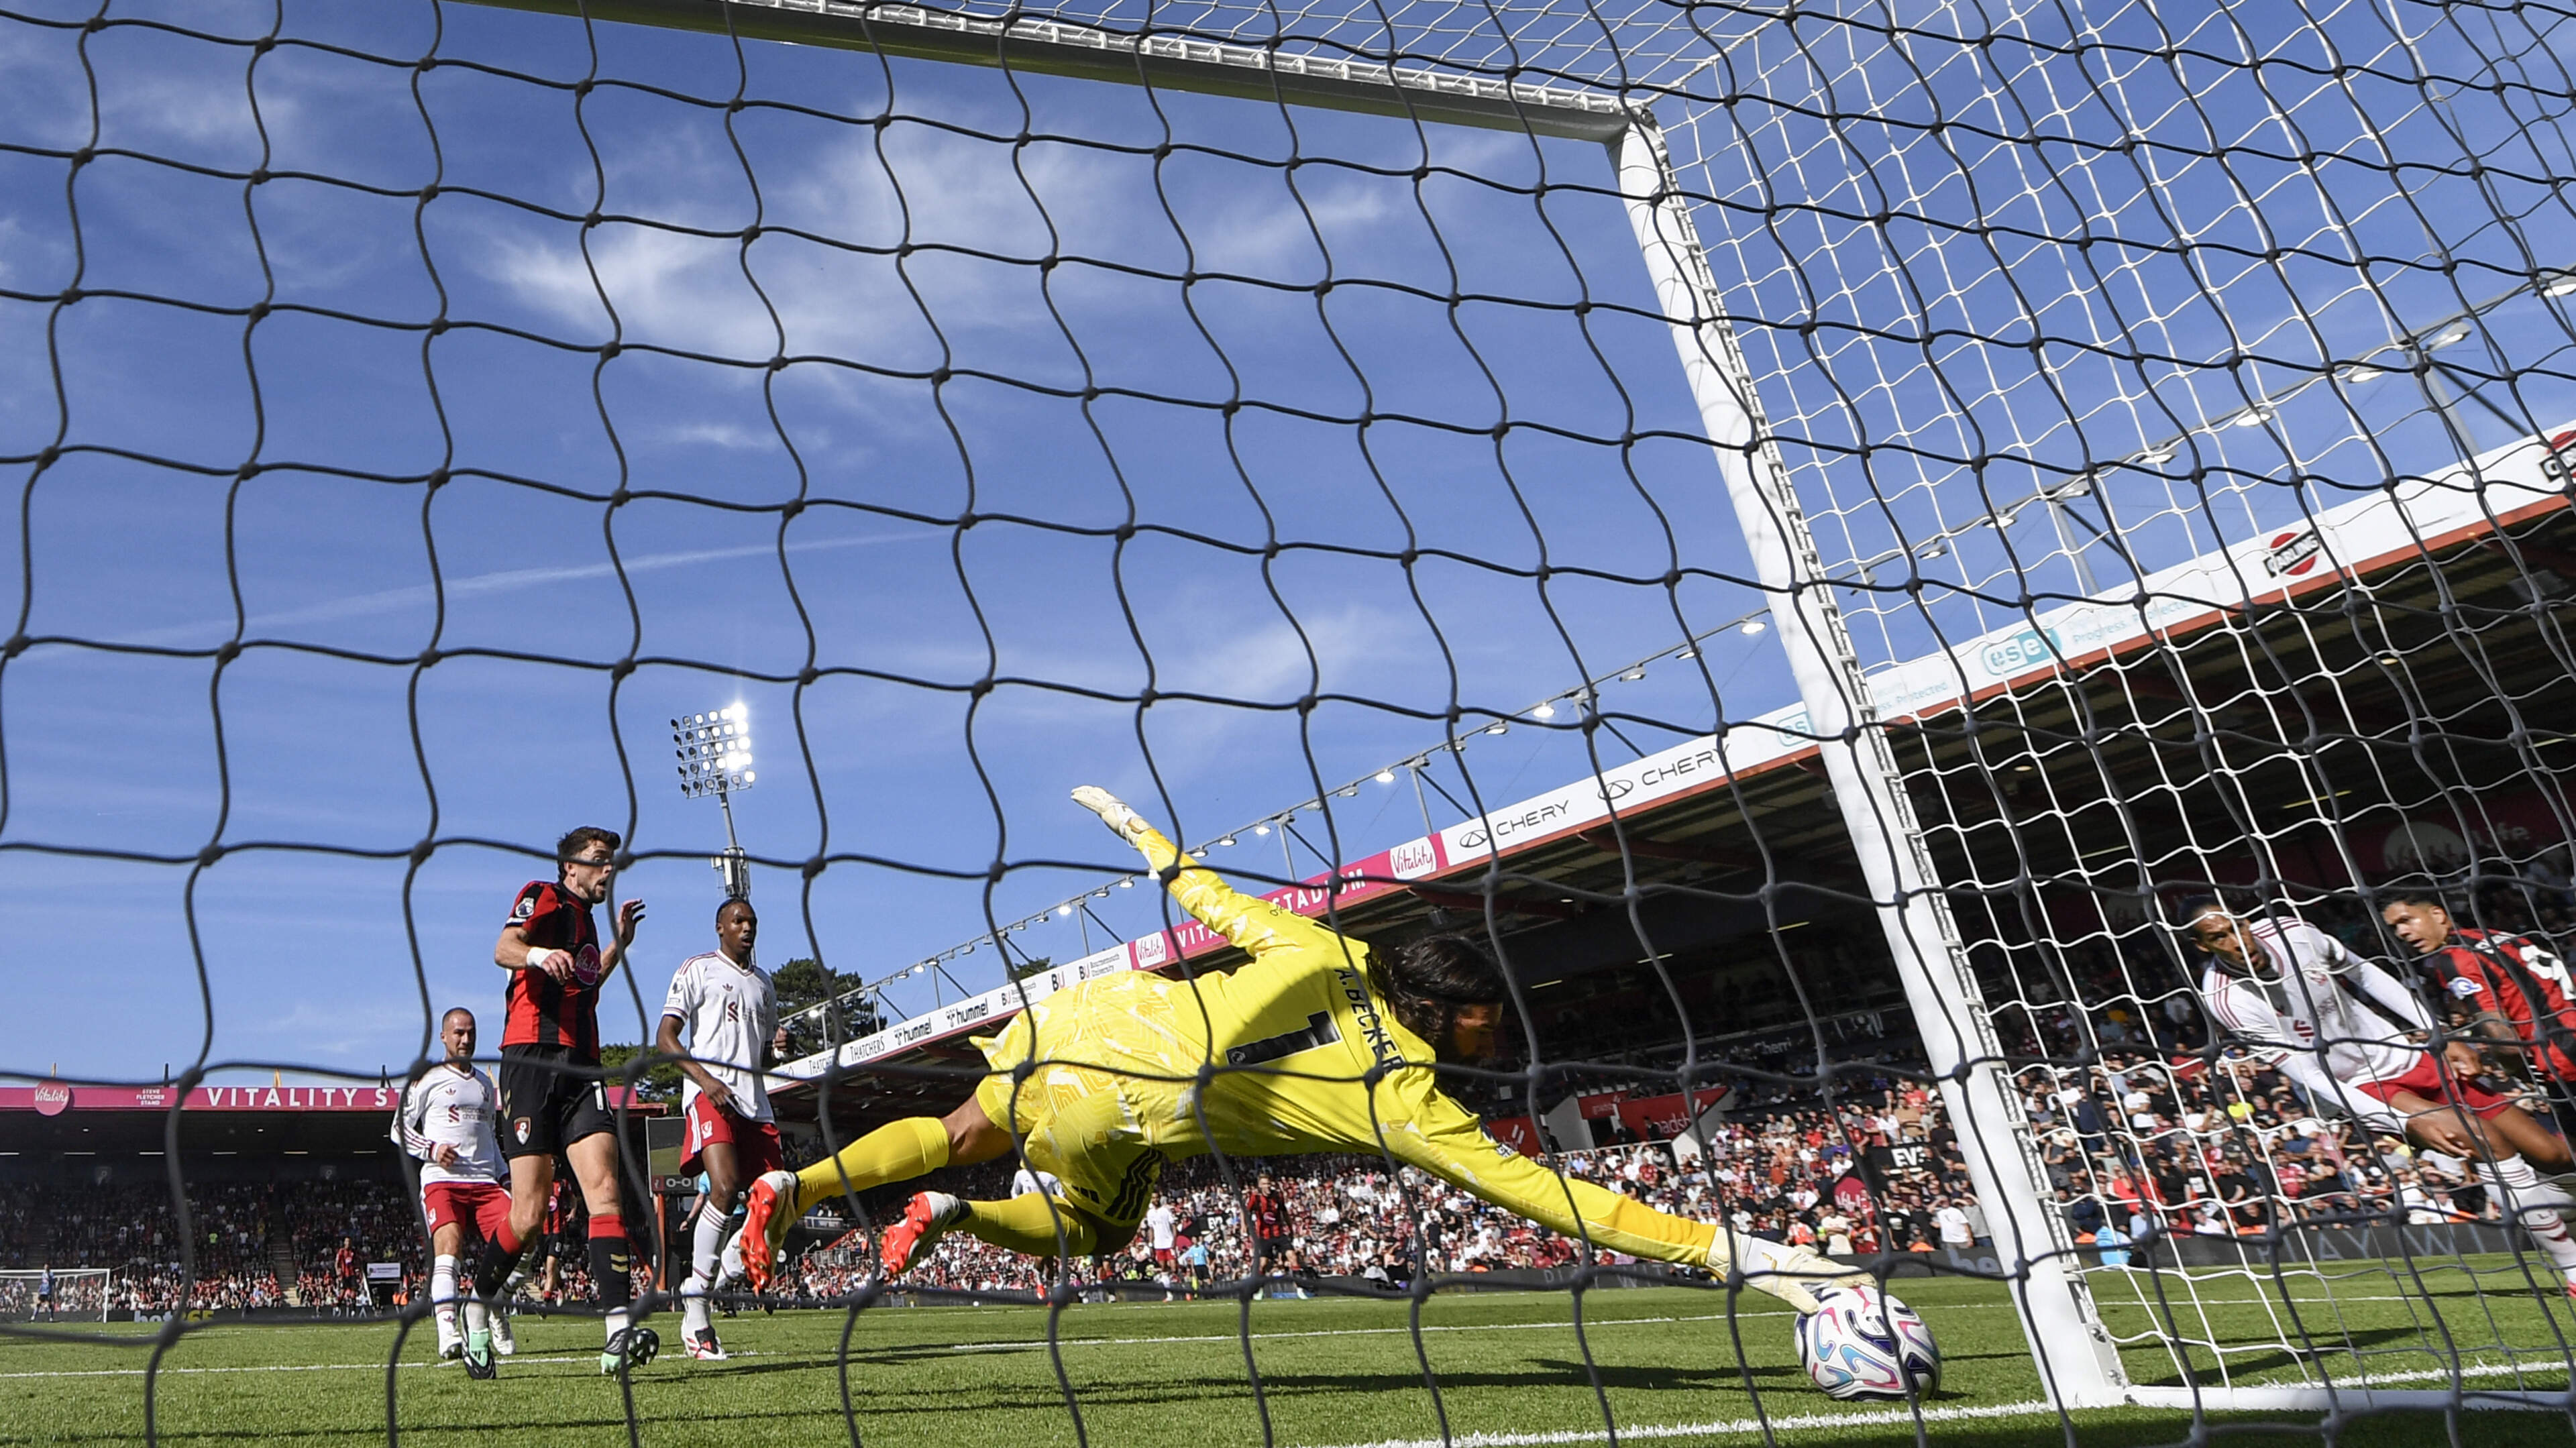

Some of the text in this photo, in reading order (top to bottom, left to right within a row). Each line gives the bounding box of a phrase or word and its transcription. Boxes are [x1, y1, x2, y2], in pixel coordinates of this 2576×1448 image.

[1642, 744, 1730, 787] CHERY
[1496, 800, 1570, 836] CHERY
[1392, 846, 1434, 875] Vitality
[956, 997, 989, 1025] hummel
[903, 1017, 932, 1043] hummel
[1225, 1010, 1342, 1066] 1
[850, 1036, 885, 1062] THATCHERS
[35, 1086, 69, 1106] Vitality
[207, 1088, 358, 1107] VITALITY
